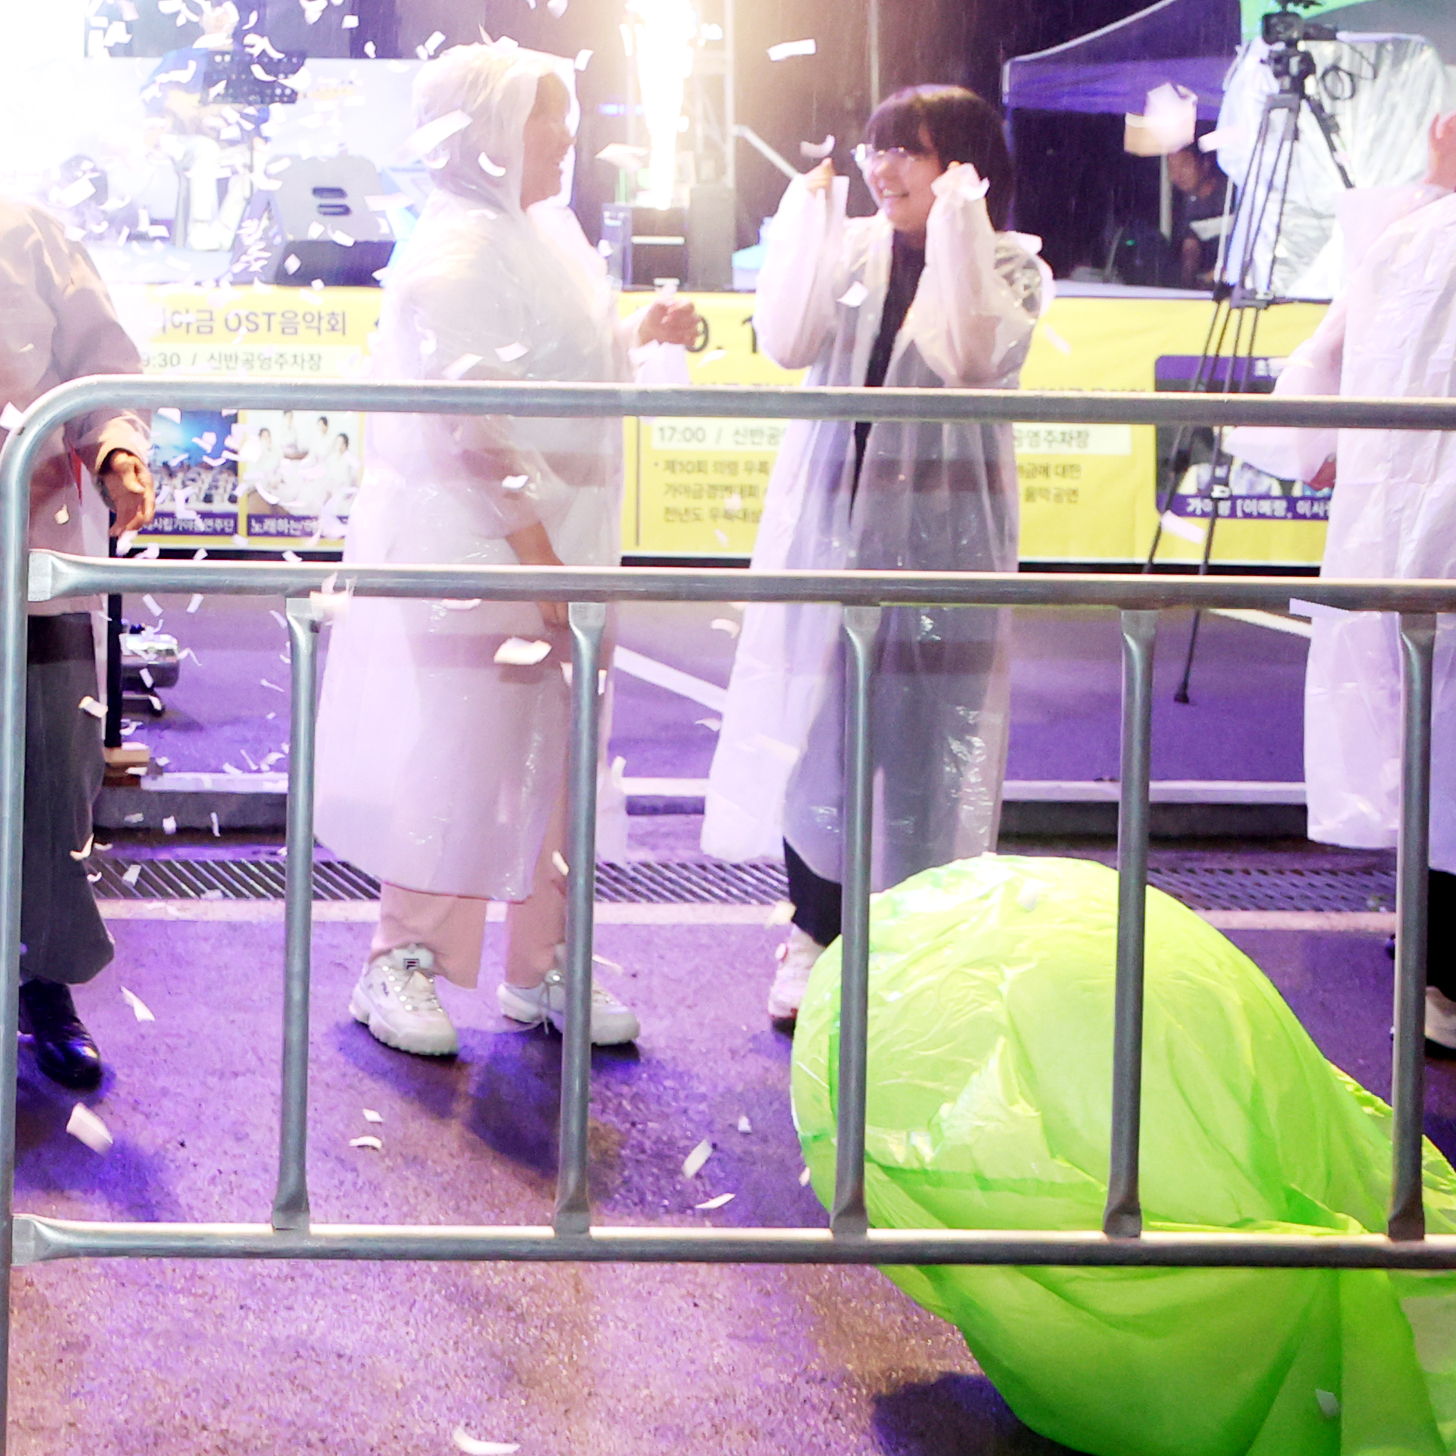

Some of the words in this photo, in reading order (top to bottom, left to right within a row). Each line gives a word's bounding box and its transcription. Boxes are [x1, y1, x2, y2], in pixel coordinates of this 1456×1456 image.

[223, 309, 347, 337] OST음악회
[207, 351, 323, 373] 신반공영주차장
[732, 425, 784, 446] 신반공
